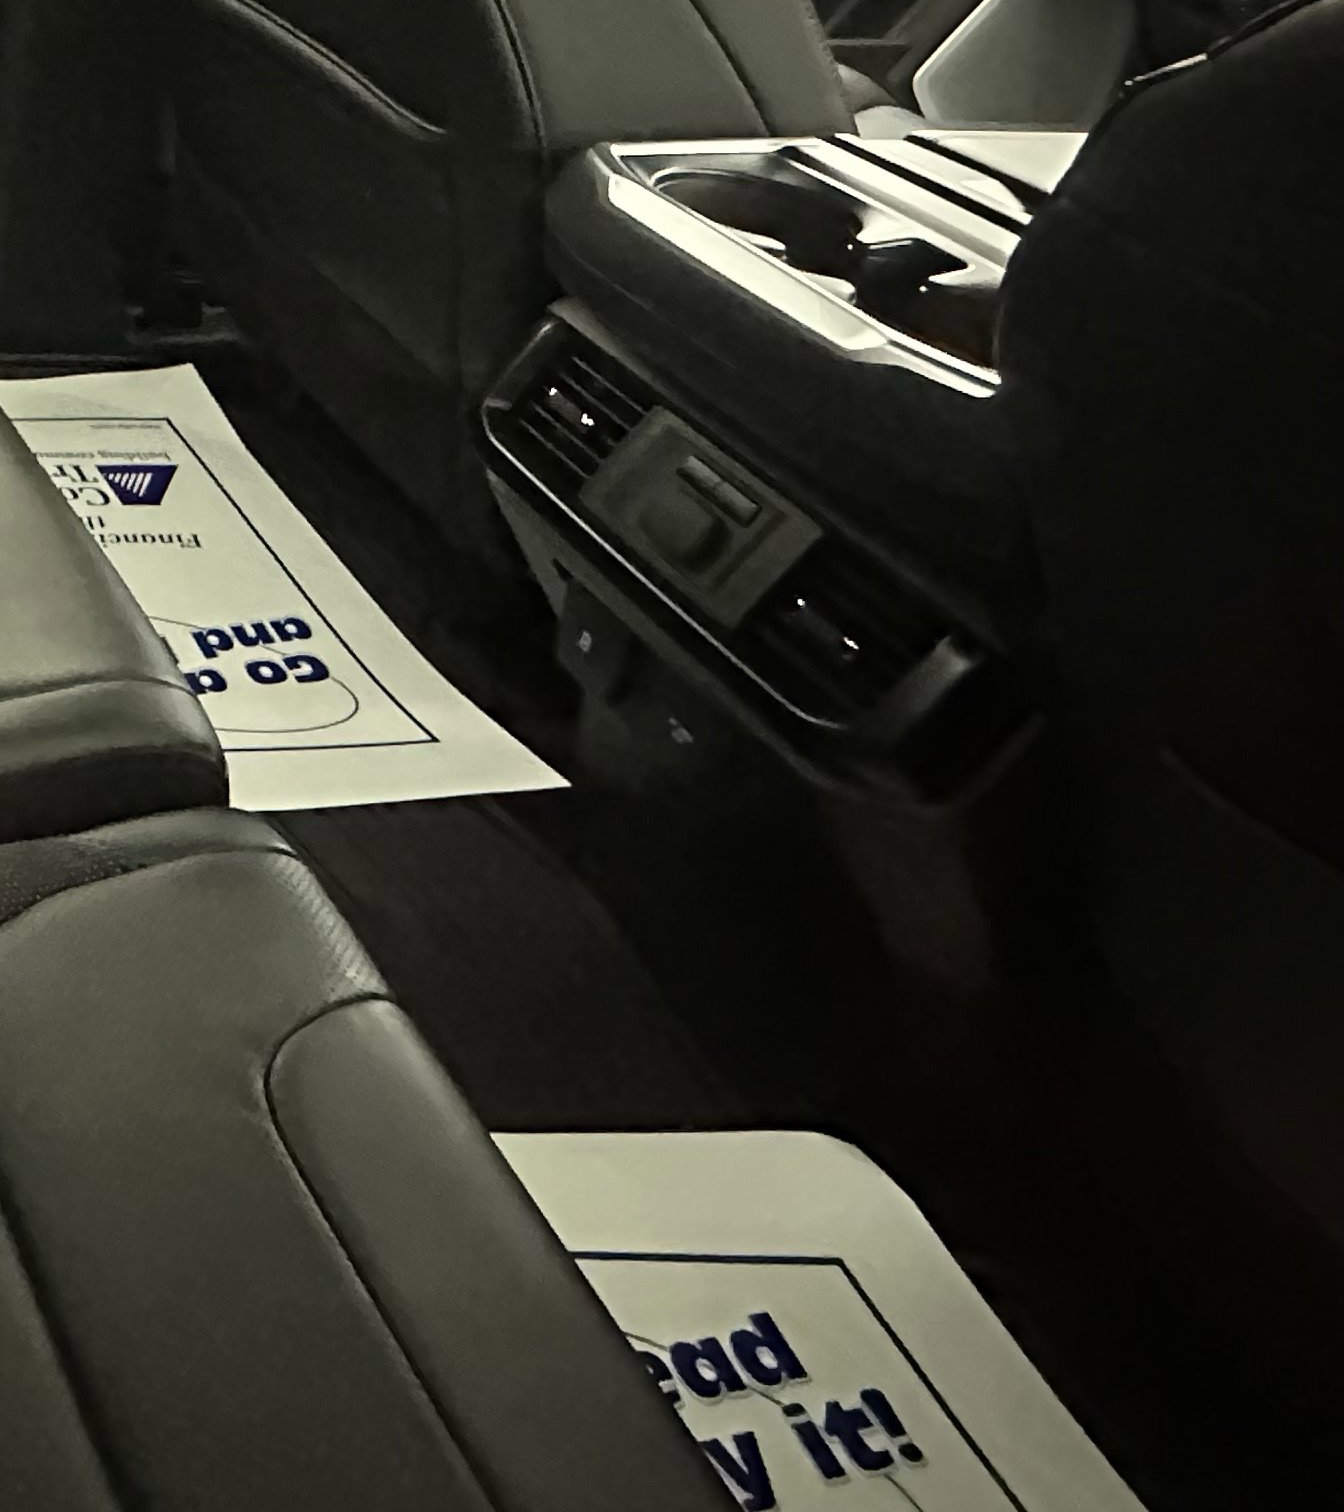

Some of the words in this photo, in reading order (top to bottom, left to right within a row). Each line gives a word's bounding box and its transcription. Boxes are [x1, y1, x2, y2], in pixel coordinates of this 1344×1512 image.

[97, 532, 202, 549] Financi
[191, 617, 312, 659] and
[245, 654, 330, 685] Go
[781, 1387, 925, 1480] it!
